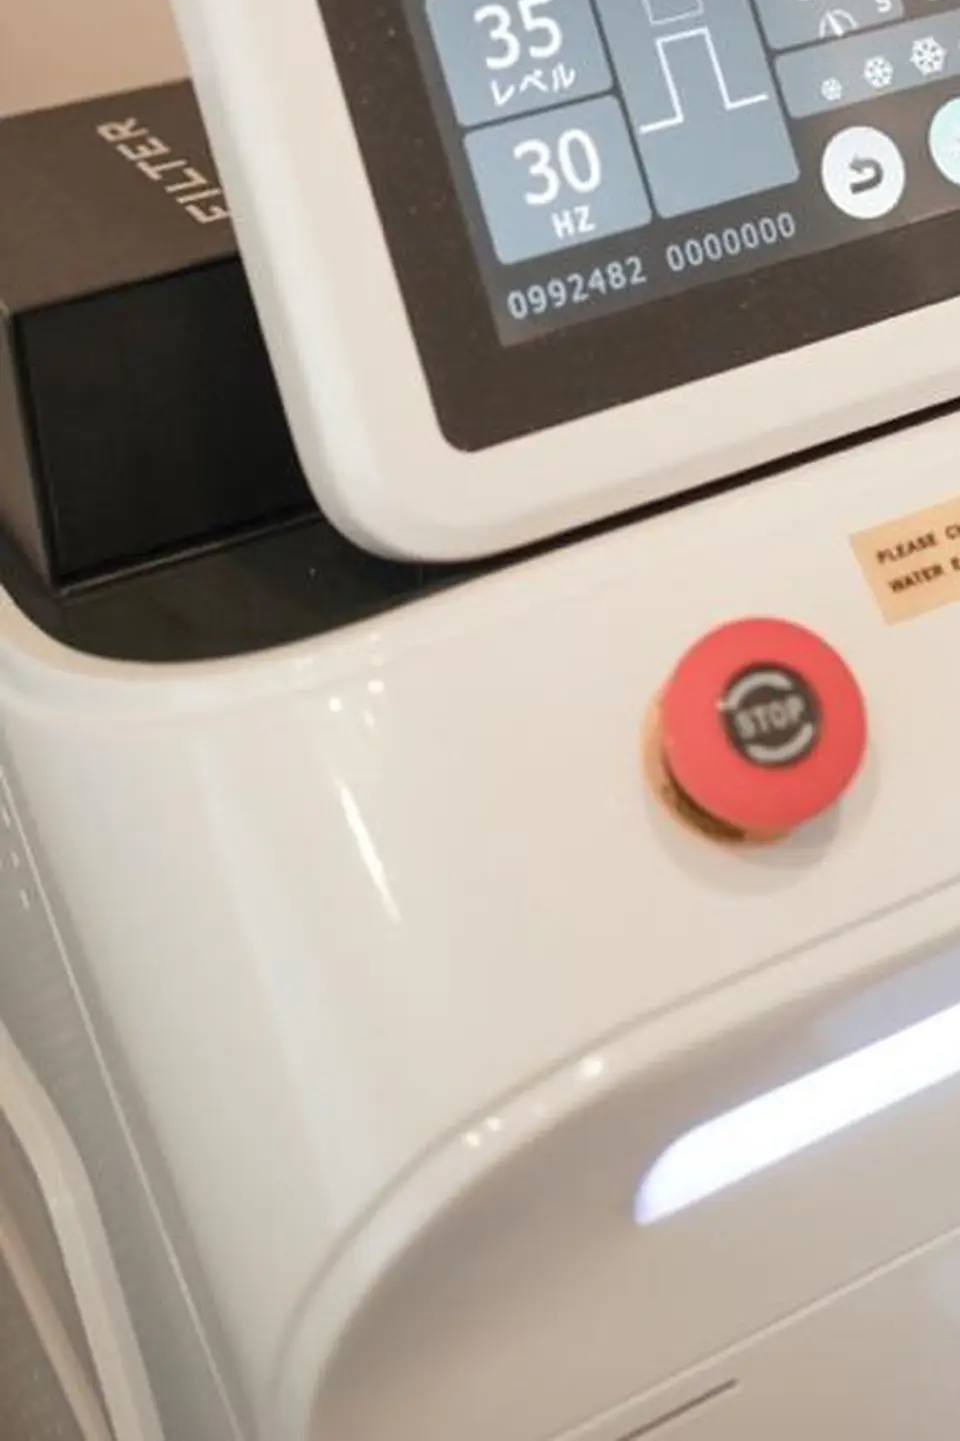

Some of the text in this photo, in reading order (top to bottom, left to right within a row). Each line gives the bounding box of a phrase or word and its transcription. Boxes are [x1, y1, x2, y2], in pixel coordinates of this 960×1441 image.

[489, 62, 577, 107] レベル
[97, 116, 232, 225] FILTER
[512, 127, 603, 206] 30
[551, 205, 598, 241] HZ
[506, 210, 797, 321] 0992482 0000000
[876, 532, 938, 565] PLEASE
[888, 563, 944, 594] WATER
[734, 693, 807, 740] STOP
